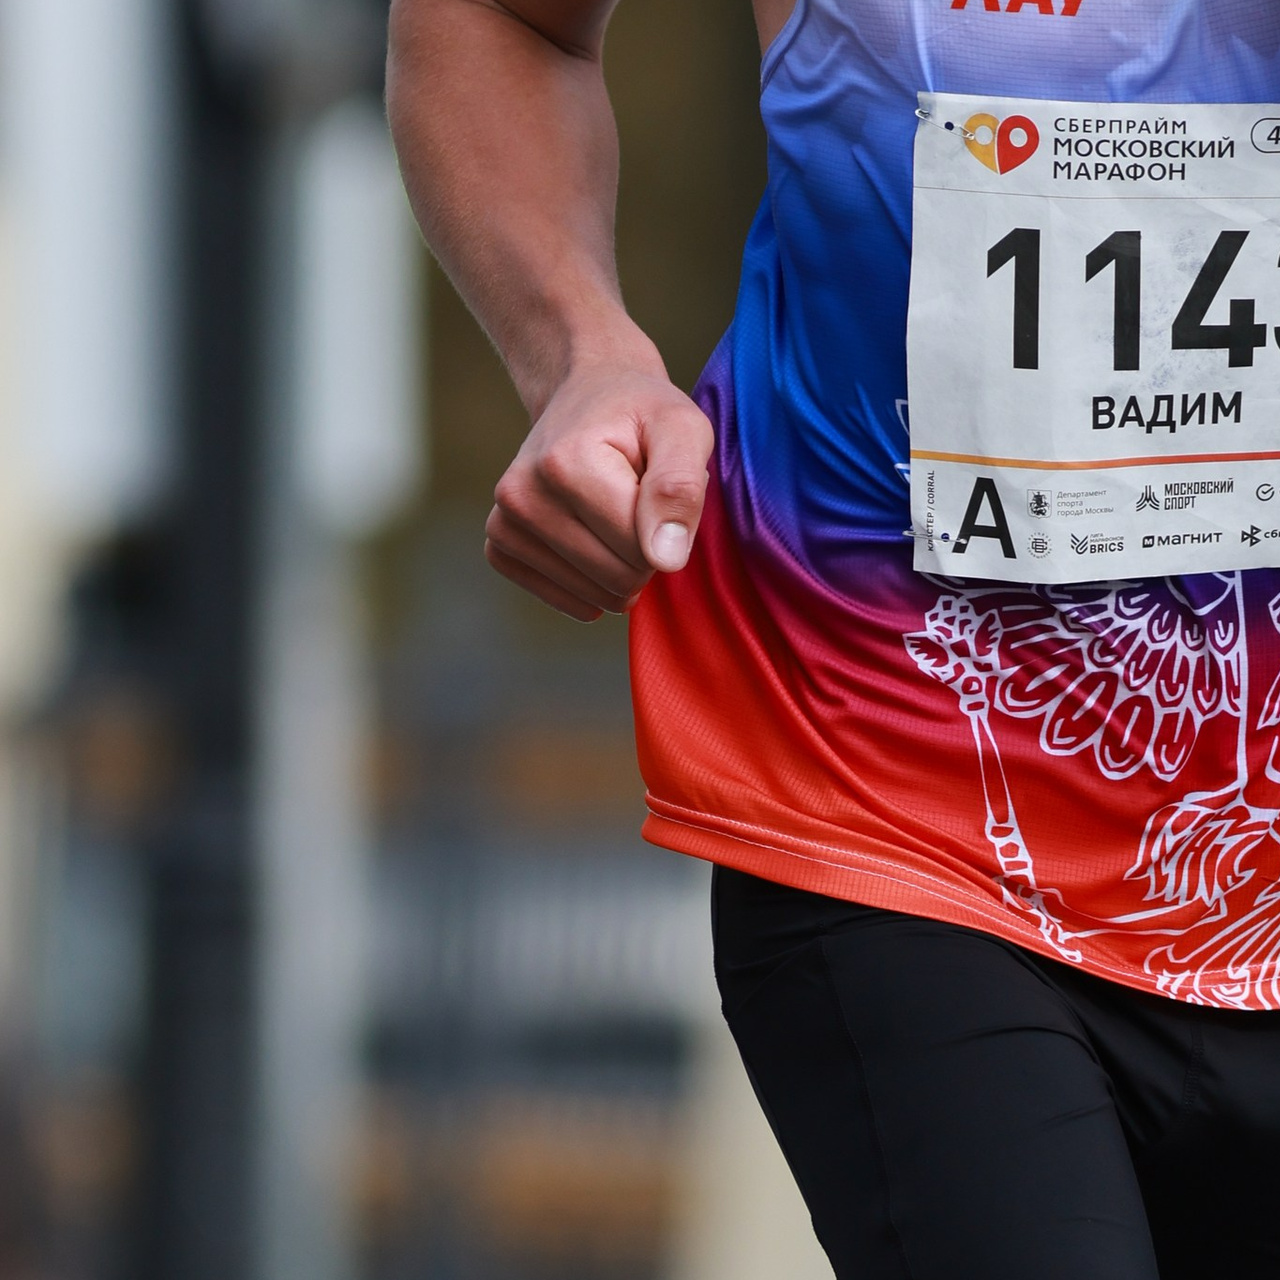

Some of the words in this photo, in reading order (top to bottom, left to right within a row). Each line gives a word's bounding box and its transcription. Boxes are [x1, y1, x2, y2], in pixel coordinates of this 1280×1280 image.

[1054, 117, 1187, 135] СБЕРПРАЙМ
[1053, 136, 1235, 158] МОСКОВСКИЙ
[1053, 161, 1186, 181] МАРАФОН
[1091, 391, 1243, 434] ВАДИМ
[927, 470, 935, 504] CORRAL
[1057, 489, 1107, 499] Департамент
[1164, 478, 1234, 497] МОСКОВСКИЙ
[1057, 500, 1083, 508] спорта
[1057, 509, 1084, 517] города
[1085, 506, 1114, 515] Москвы
[1164, 496, 1197, 511] СПОРТ
[1090, 542, 1124, 554] BRICS
